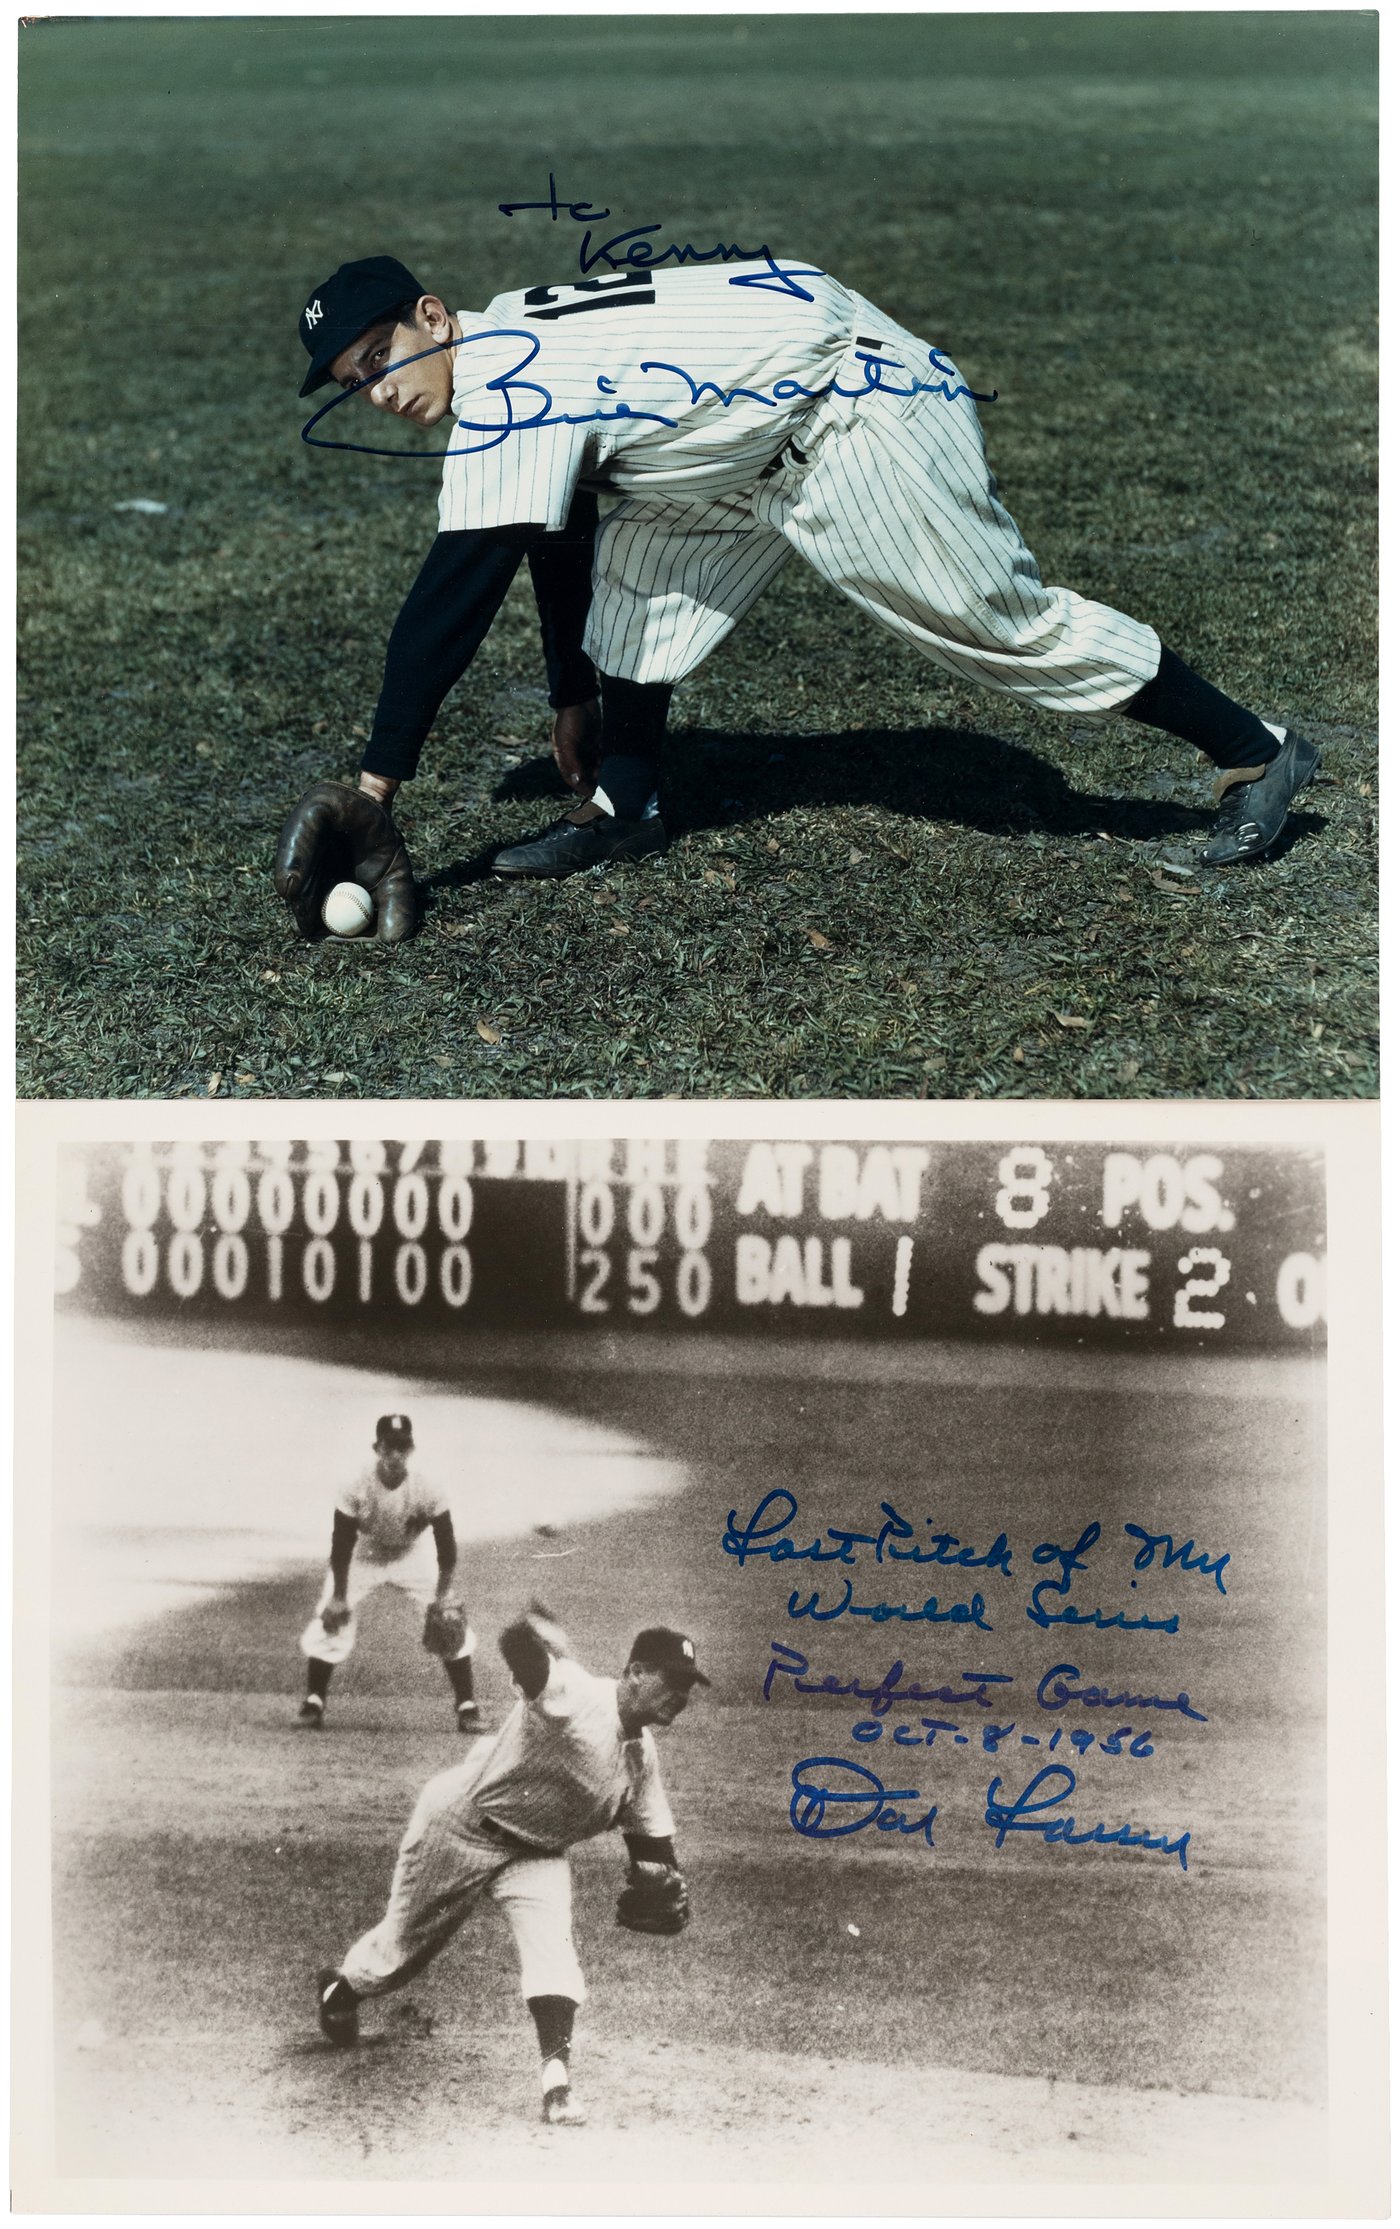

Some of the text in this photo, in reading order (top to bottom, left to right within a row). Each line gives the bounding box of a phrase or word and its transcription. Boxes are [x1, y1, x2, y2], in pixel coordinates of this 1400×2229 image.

[579, 223, 828, 304] Kenny
[736, 1142, 814, 1218] AT
[818, 1144, 931, 1223] BAT
[995, 1146, 1053, 1229] 8
[1102, 1153, 1237, 1233] POS.
[735, 1234, 864, 1308] BALL
[972, 1242, 1151, 1320] STRIKE
[1173, 1247, 1231, 1329] 2
[1031, 1522, 1101, 1596] of
[1124, 1522, 1233, 1595] My
[1036, 1663, 1210, 1722] Game
